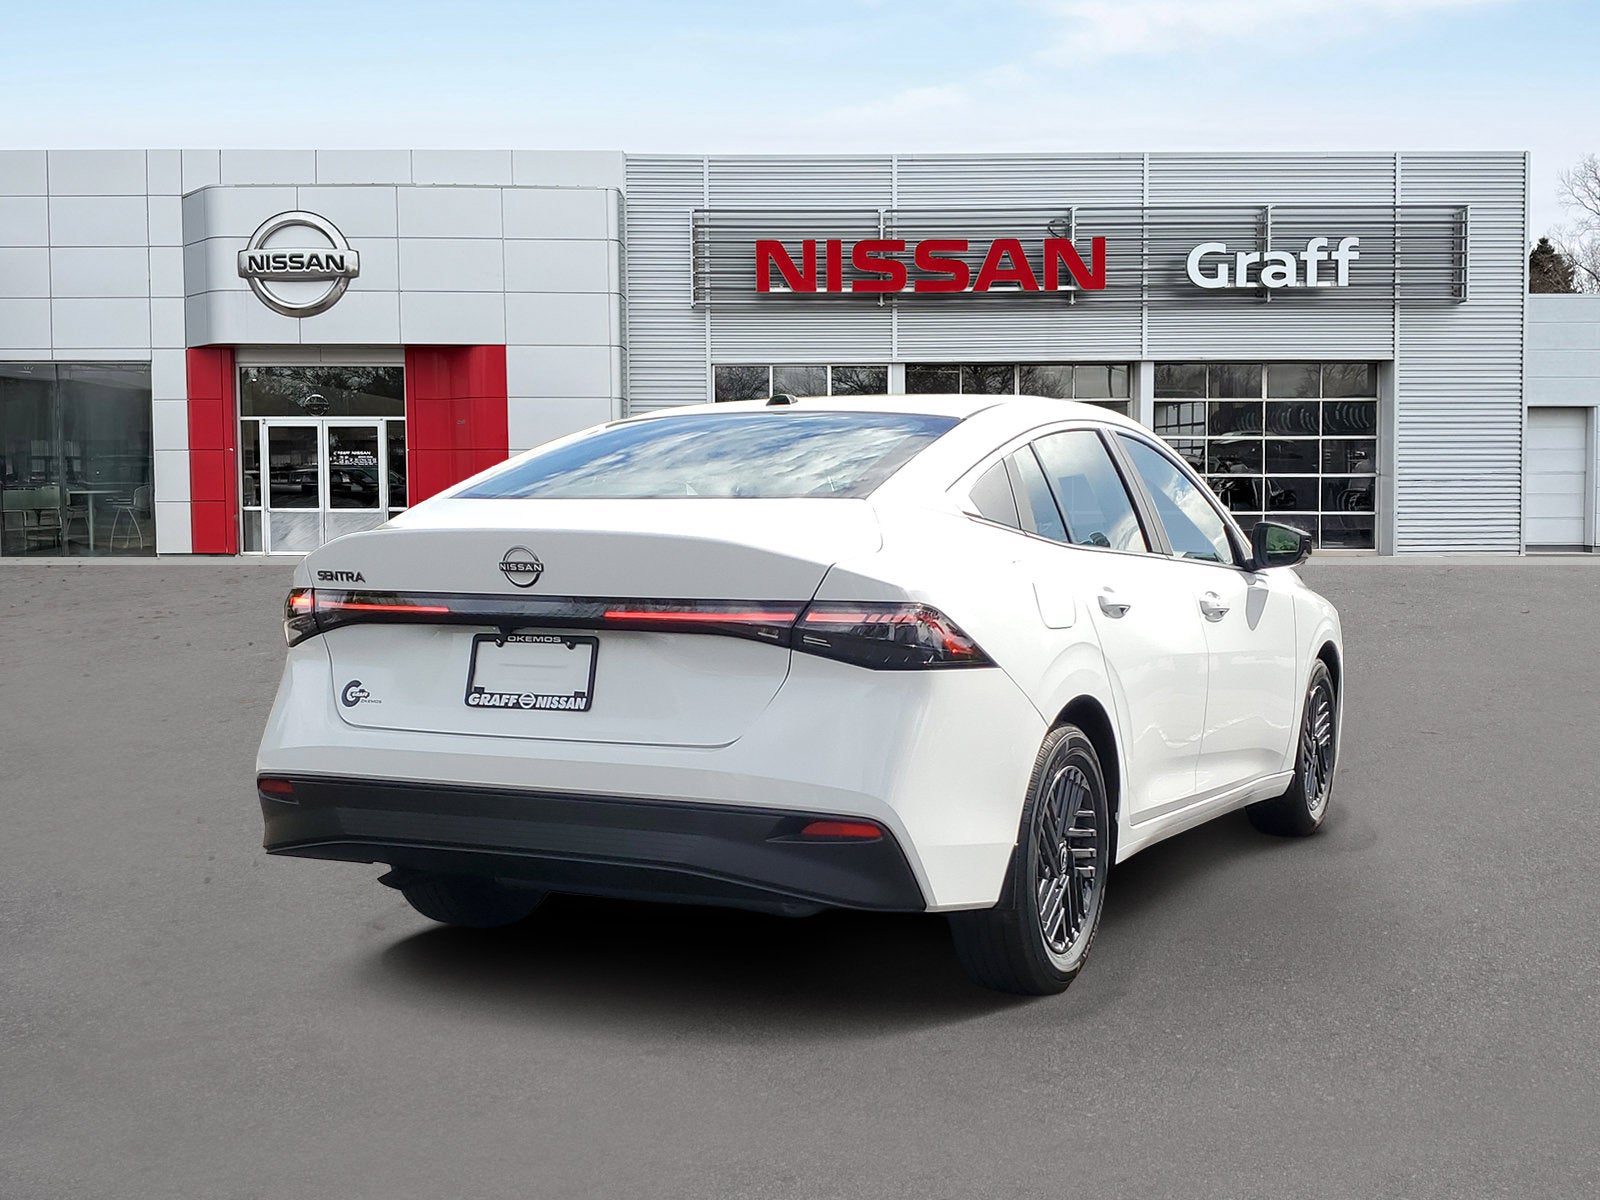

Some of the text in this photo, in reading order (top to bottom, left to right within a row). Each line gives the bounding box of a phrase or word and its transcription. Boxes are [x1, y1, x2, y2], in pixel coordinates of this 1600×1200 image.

[248, 253, 345, 271] NISSAN
[755, 237, 1106, 293] NISSAN
[1187, 237, 1360, 288] Graff
[500, 563, 542, 571] NISSAN
[317, 570, 366, 583] SENTRA
[507, 635, 562, 643] OKEMOS
[468, 693, 587, 710] GRAFF NISSAN
